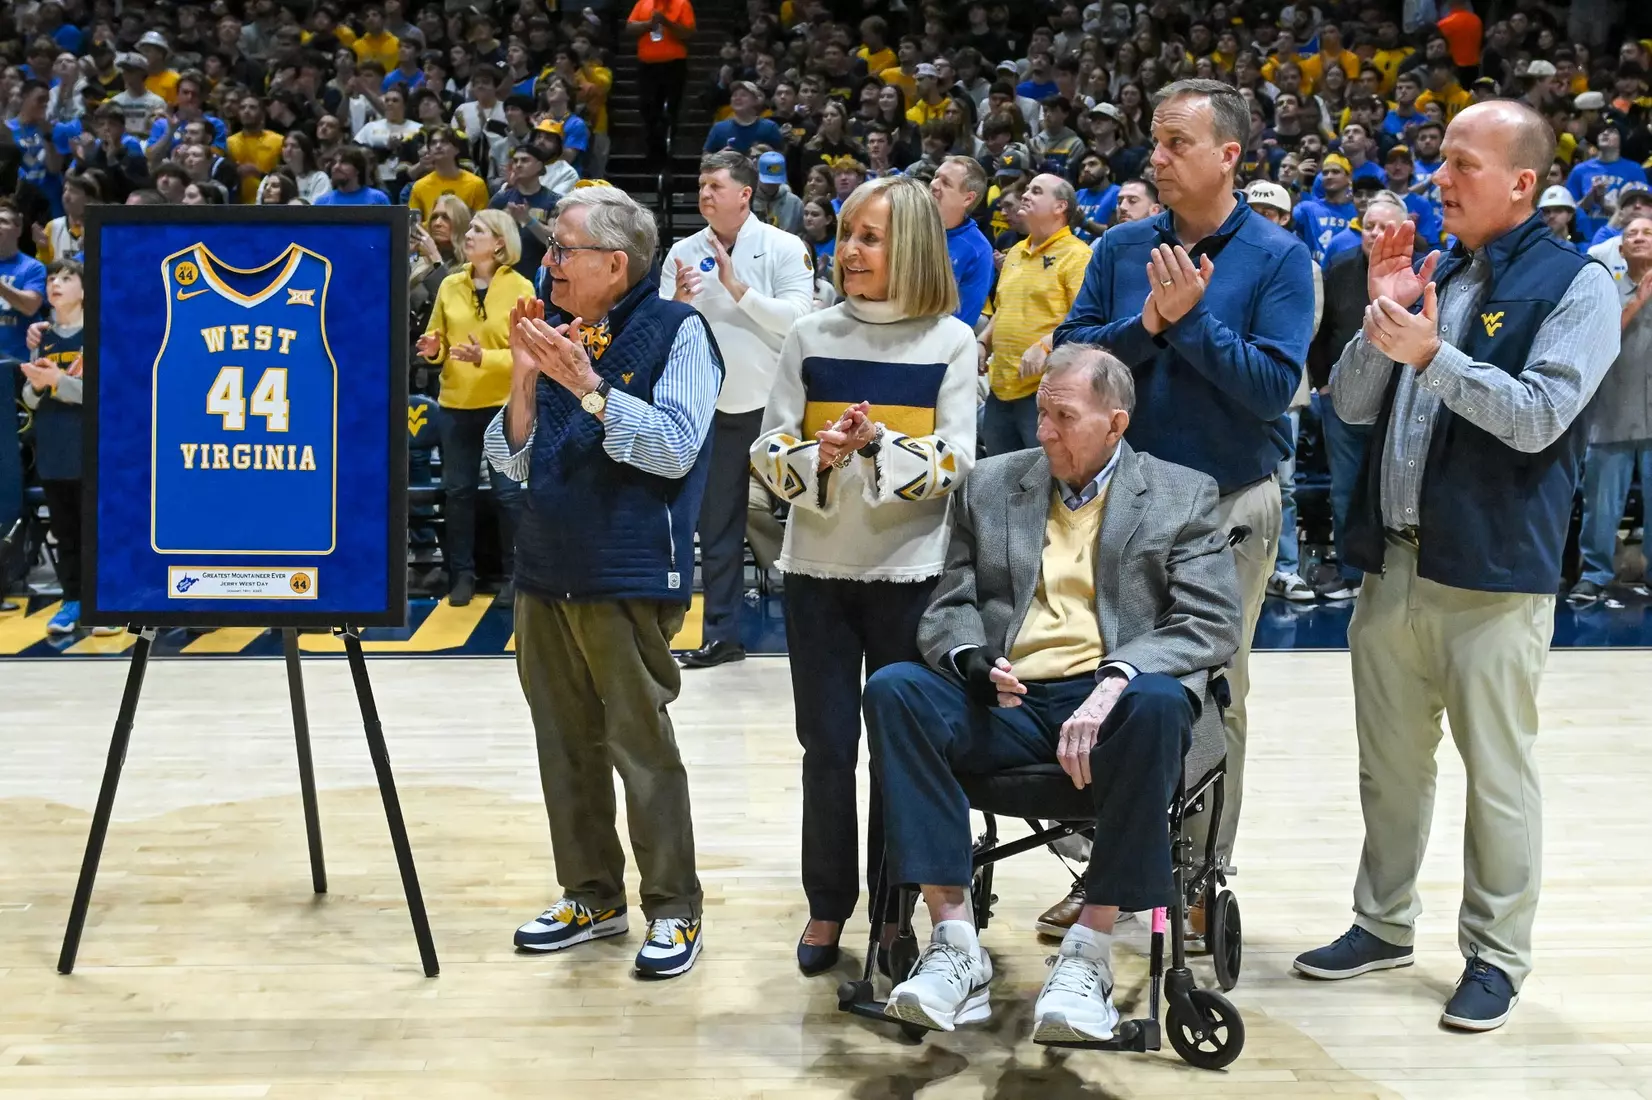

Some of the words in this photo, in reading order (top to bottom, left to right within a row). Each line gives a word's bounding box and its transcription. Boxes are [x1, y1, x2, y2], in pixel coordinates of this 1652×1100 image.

[178, 270, 193, 281] 44
[201, 325, 297, 354] WEST
[206, 366, 290, 432] 44
[180, 444, 316, 470] VIRGINIA
[293, 580, 307, 590] 44
